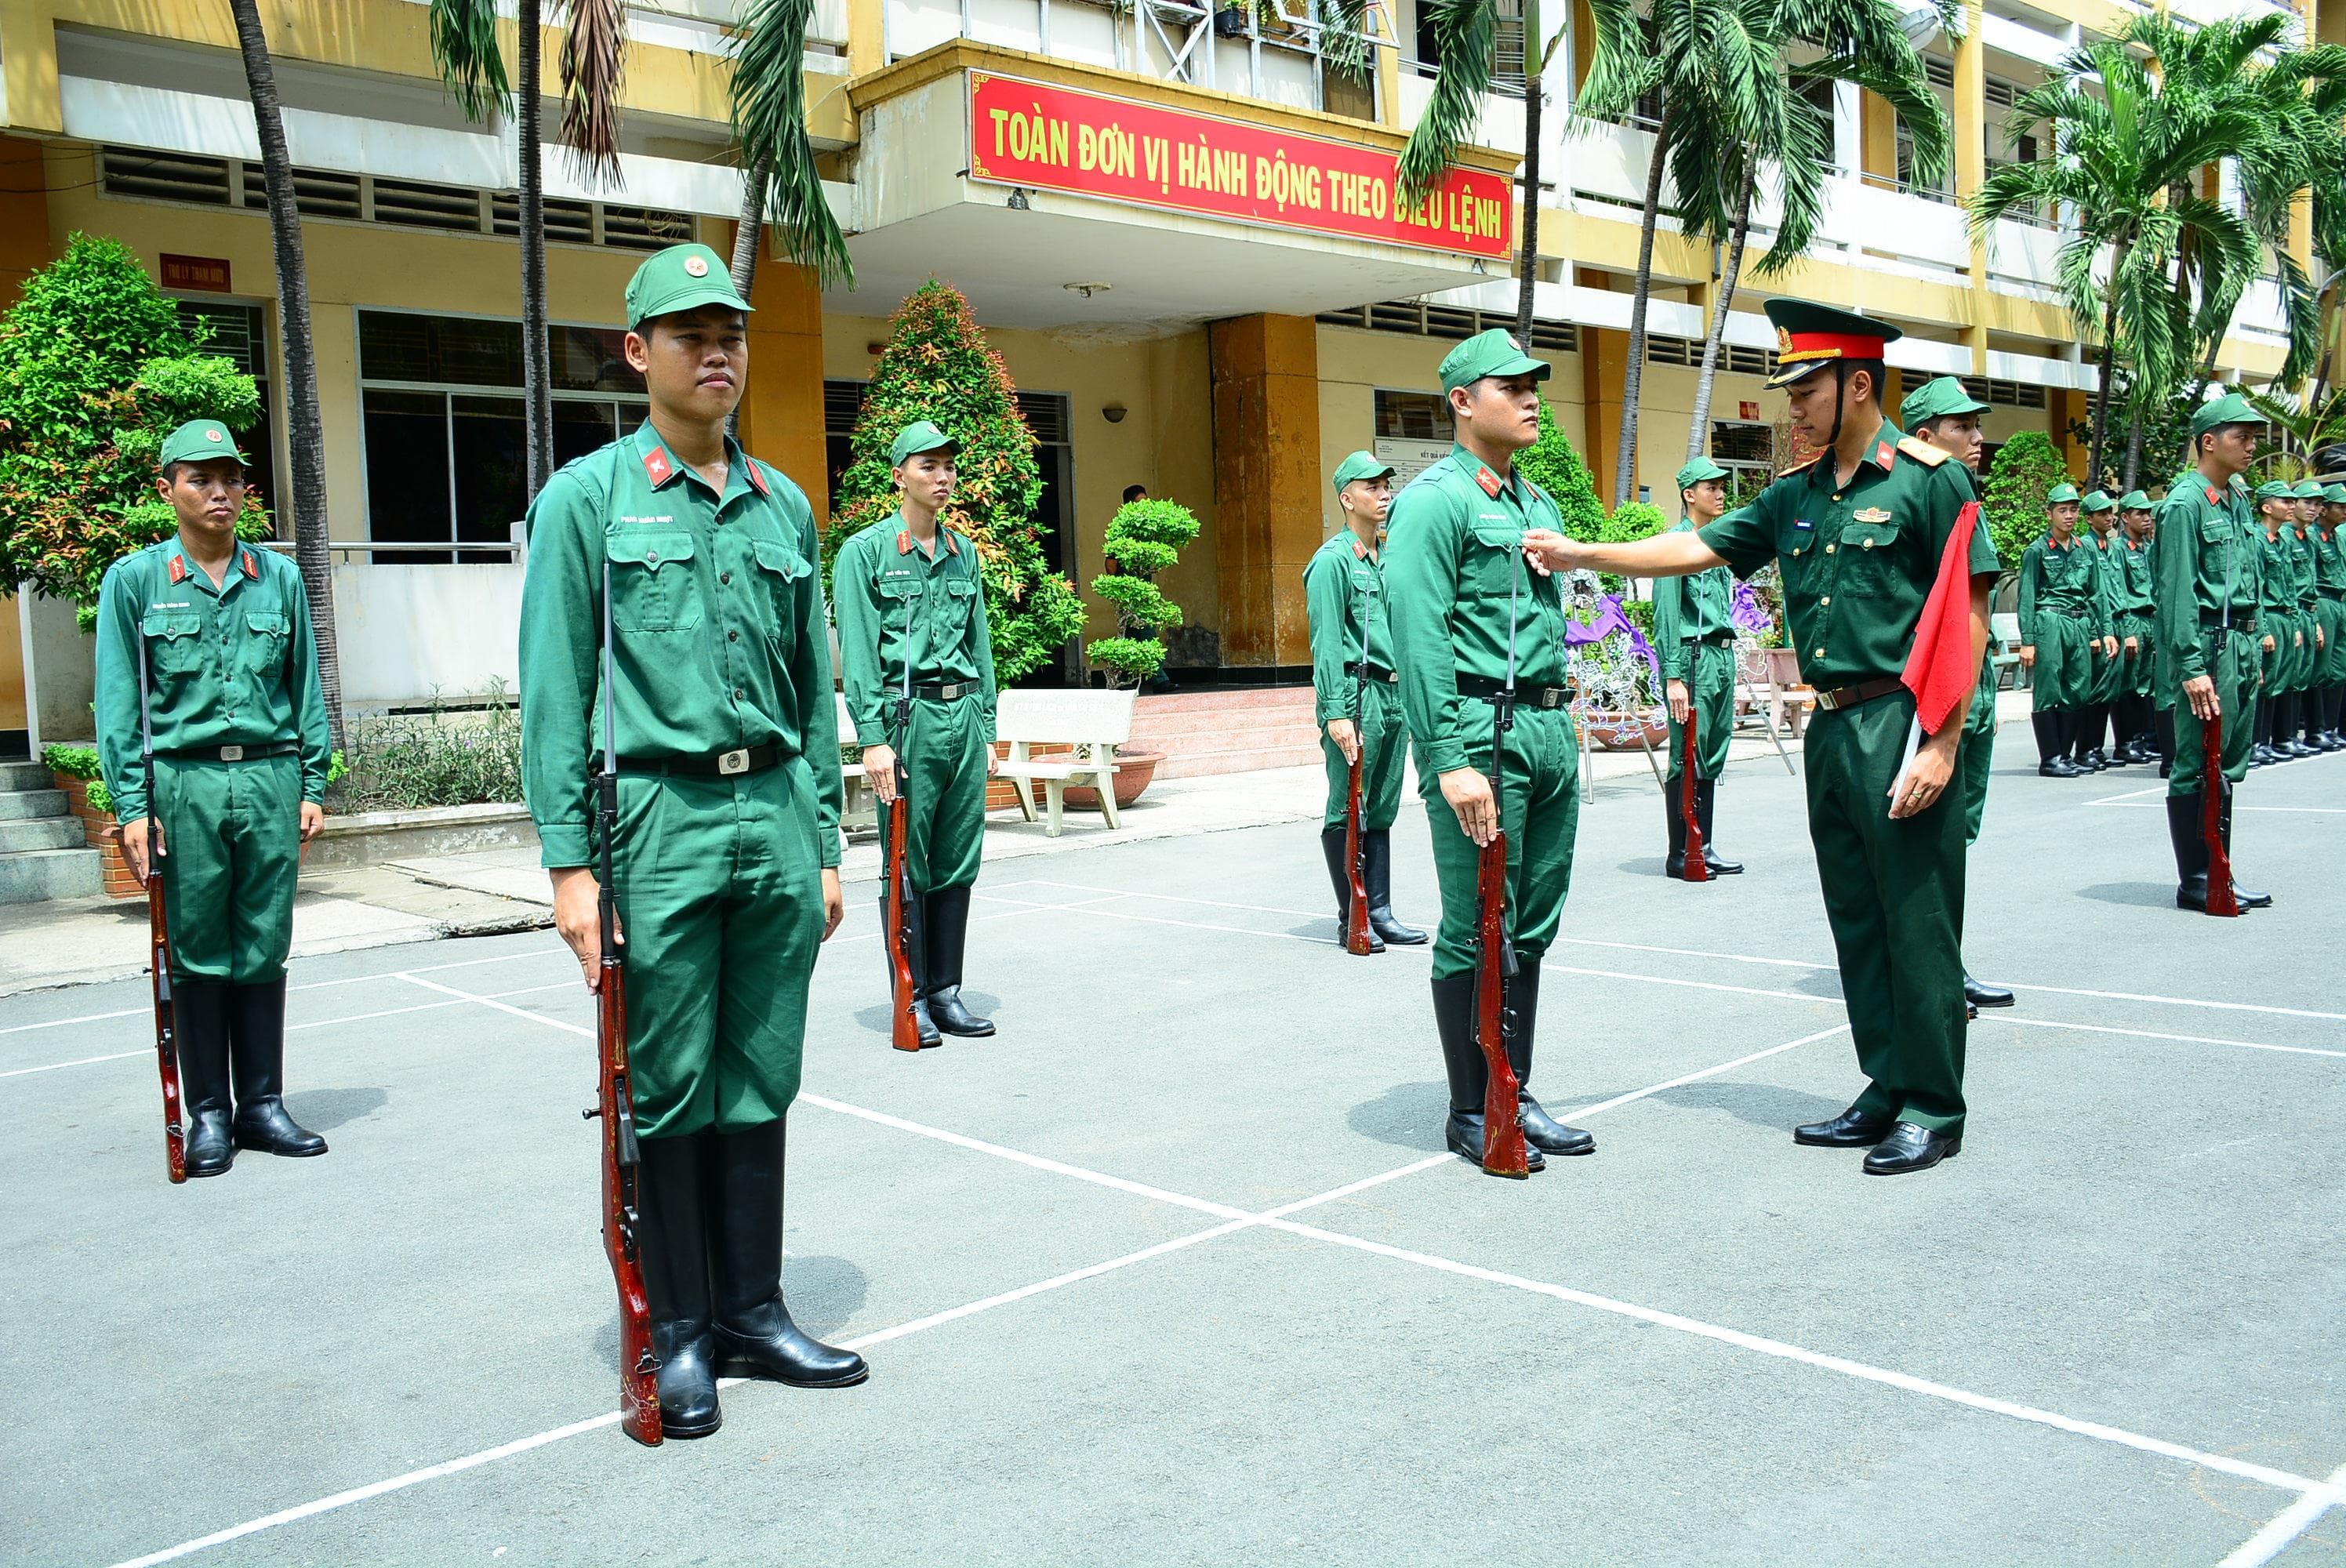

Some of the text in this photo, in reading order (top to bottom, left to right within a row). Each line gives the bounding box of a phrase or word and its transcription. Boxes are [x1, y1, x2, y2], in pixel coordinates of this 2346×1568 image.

[990, 102, 1069, 168] TOÀN
[1078, 122, 1135, 178] ĐƠN
[1142, 136, 1169, 195] VỊ
[1178, 133, 1247, 197] HÀNH
[1255, 148, 1321, 212] ĐỘNG
[1327, 169, 1387, 221] THEO
[1449, 183, 1502, 242] LỆNH
